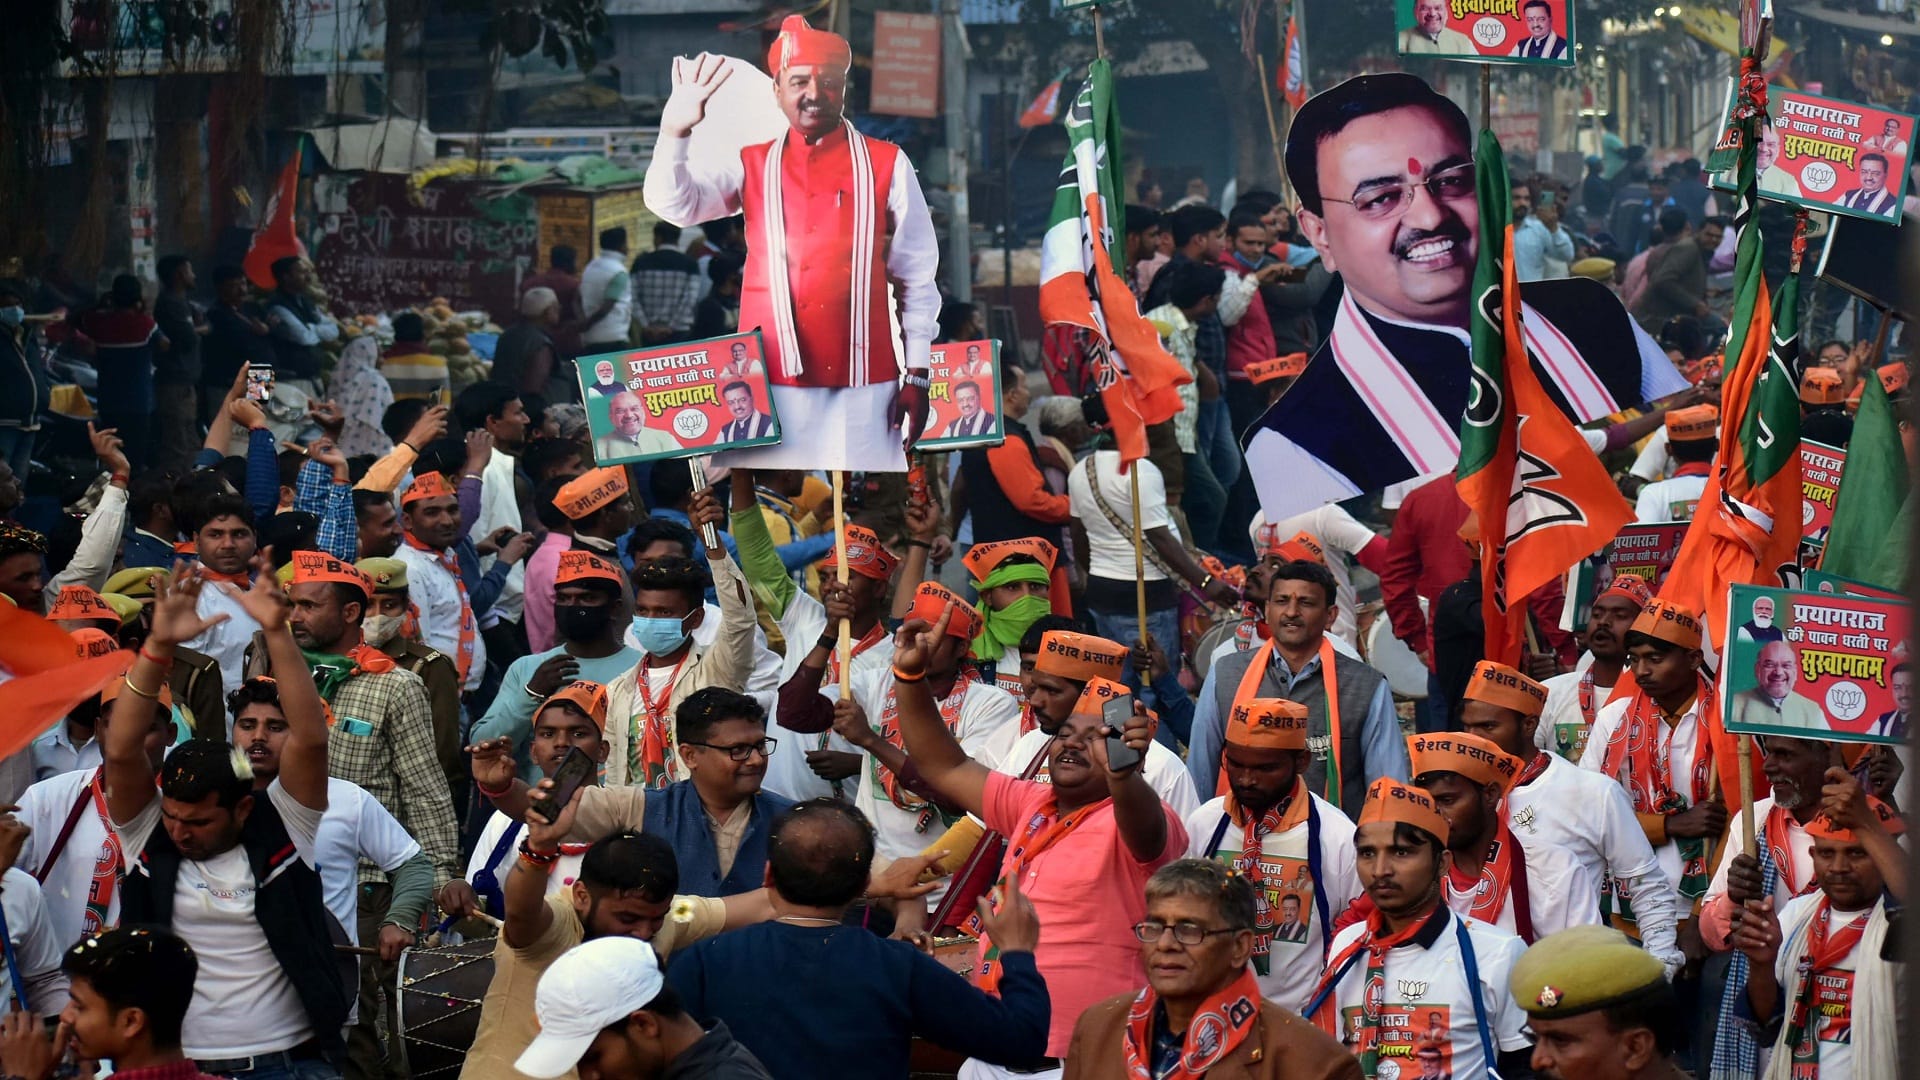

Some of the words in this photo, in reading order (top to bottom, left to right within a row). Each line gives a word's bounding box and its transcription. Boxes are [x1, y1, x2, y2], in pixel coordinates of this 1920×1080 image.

[1783, 100, 1861, 128] प्रयागराज
[1776, 117, 1790, 129] की
[1793, 121, 1818, 134] पावन
[1822, 126, 1844, 139] धरती
[1848, 132, 1861, 143] पर
[1785, 134, 1855, 170] सुस्वागतम्
[628, 350, 709, 376] प्रयागराज
[628, 376, 643, 390] की
[646, 374, 672, 387] पावन
[677, 369, 700, 383] धरती
[703, 367, 716, 379] पर
[643, 383, 722, 417] सुस्वागतम्
[1613, 534, 1660, 550] प्रयागराज
[1662, 606, 1694, 629] केशव
[1793, 604, 1886, 631] प्रयागराज
[1046, 639, 1079, 659] केशव
[1787, 627, 1804, 642] की
[1808, 631, 1838, 646] पावन
[1842, 634, 1869, 650] धरती
[1873, 638, 1889, 651] पर
[1482, 665, 1517, 687] केशव
[1801, 650, 1885, 687] सुस्वागतम्
[1258, 711, 1294, 729] केशव
[1415, 737, 1452, 753] केशव
[1455, 743, 1496, 765] प्रसाद
[1390, 786, 1431, 810] केशव
